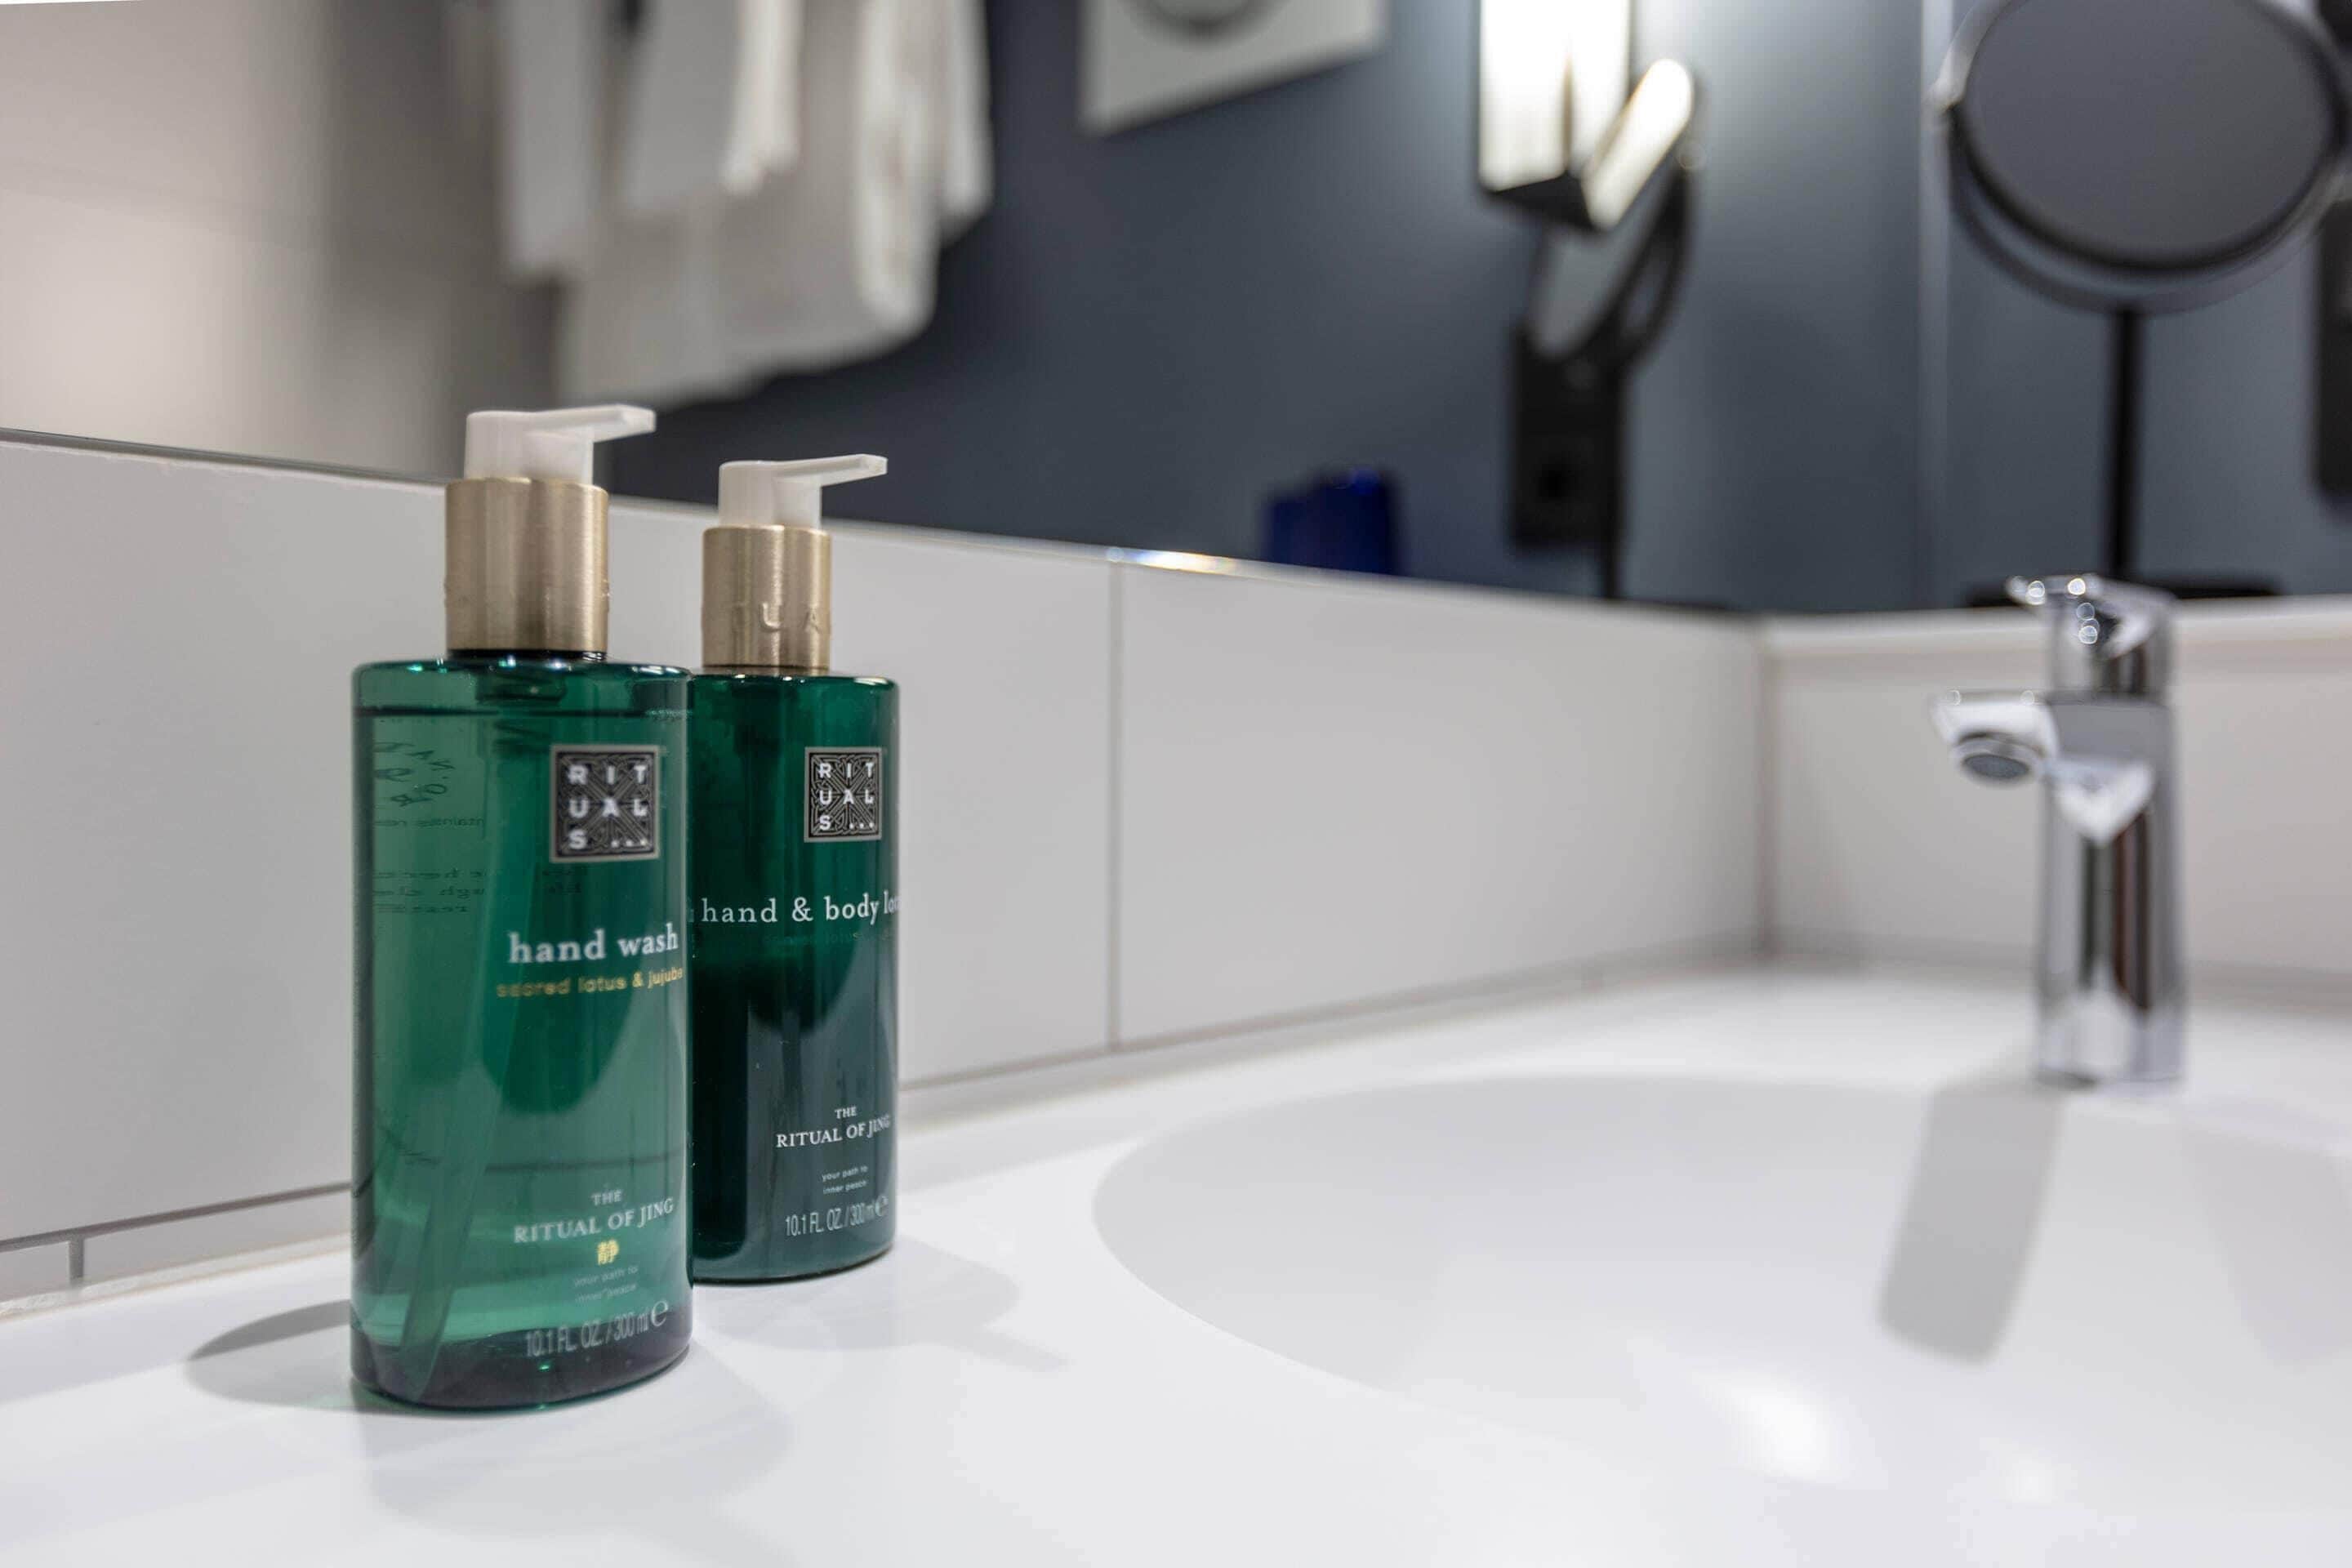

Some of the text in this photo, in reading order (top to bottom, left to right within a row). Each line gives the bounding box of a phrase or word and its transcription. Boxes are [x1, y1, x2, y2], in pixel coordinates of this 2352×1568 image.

[701, 898, 777, 923] hand
[791, 896, 813, 922] &
[823, 892, 880, 925] body
[507, 921, 679, 964] hand wash
[496, 966, 684, 998] sacred lotus & jujube
[835, 1106, 858, 1120] THE
[776, 1114, 891, 1148] RITUAL OF JING
[822, 1171, 840, 1183] your
[591, 1189, 623, 1206] THE
[513, 1197, 674, 1244] RITUAL OF JING
[785, 1214, 807, 1236] 10.1
[525, 1330, 555, 1357] 10.1
[613, 1311, 635, 1341] 300
